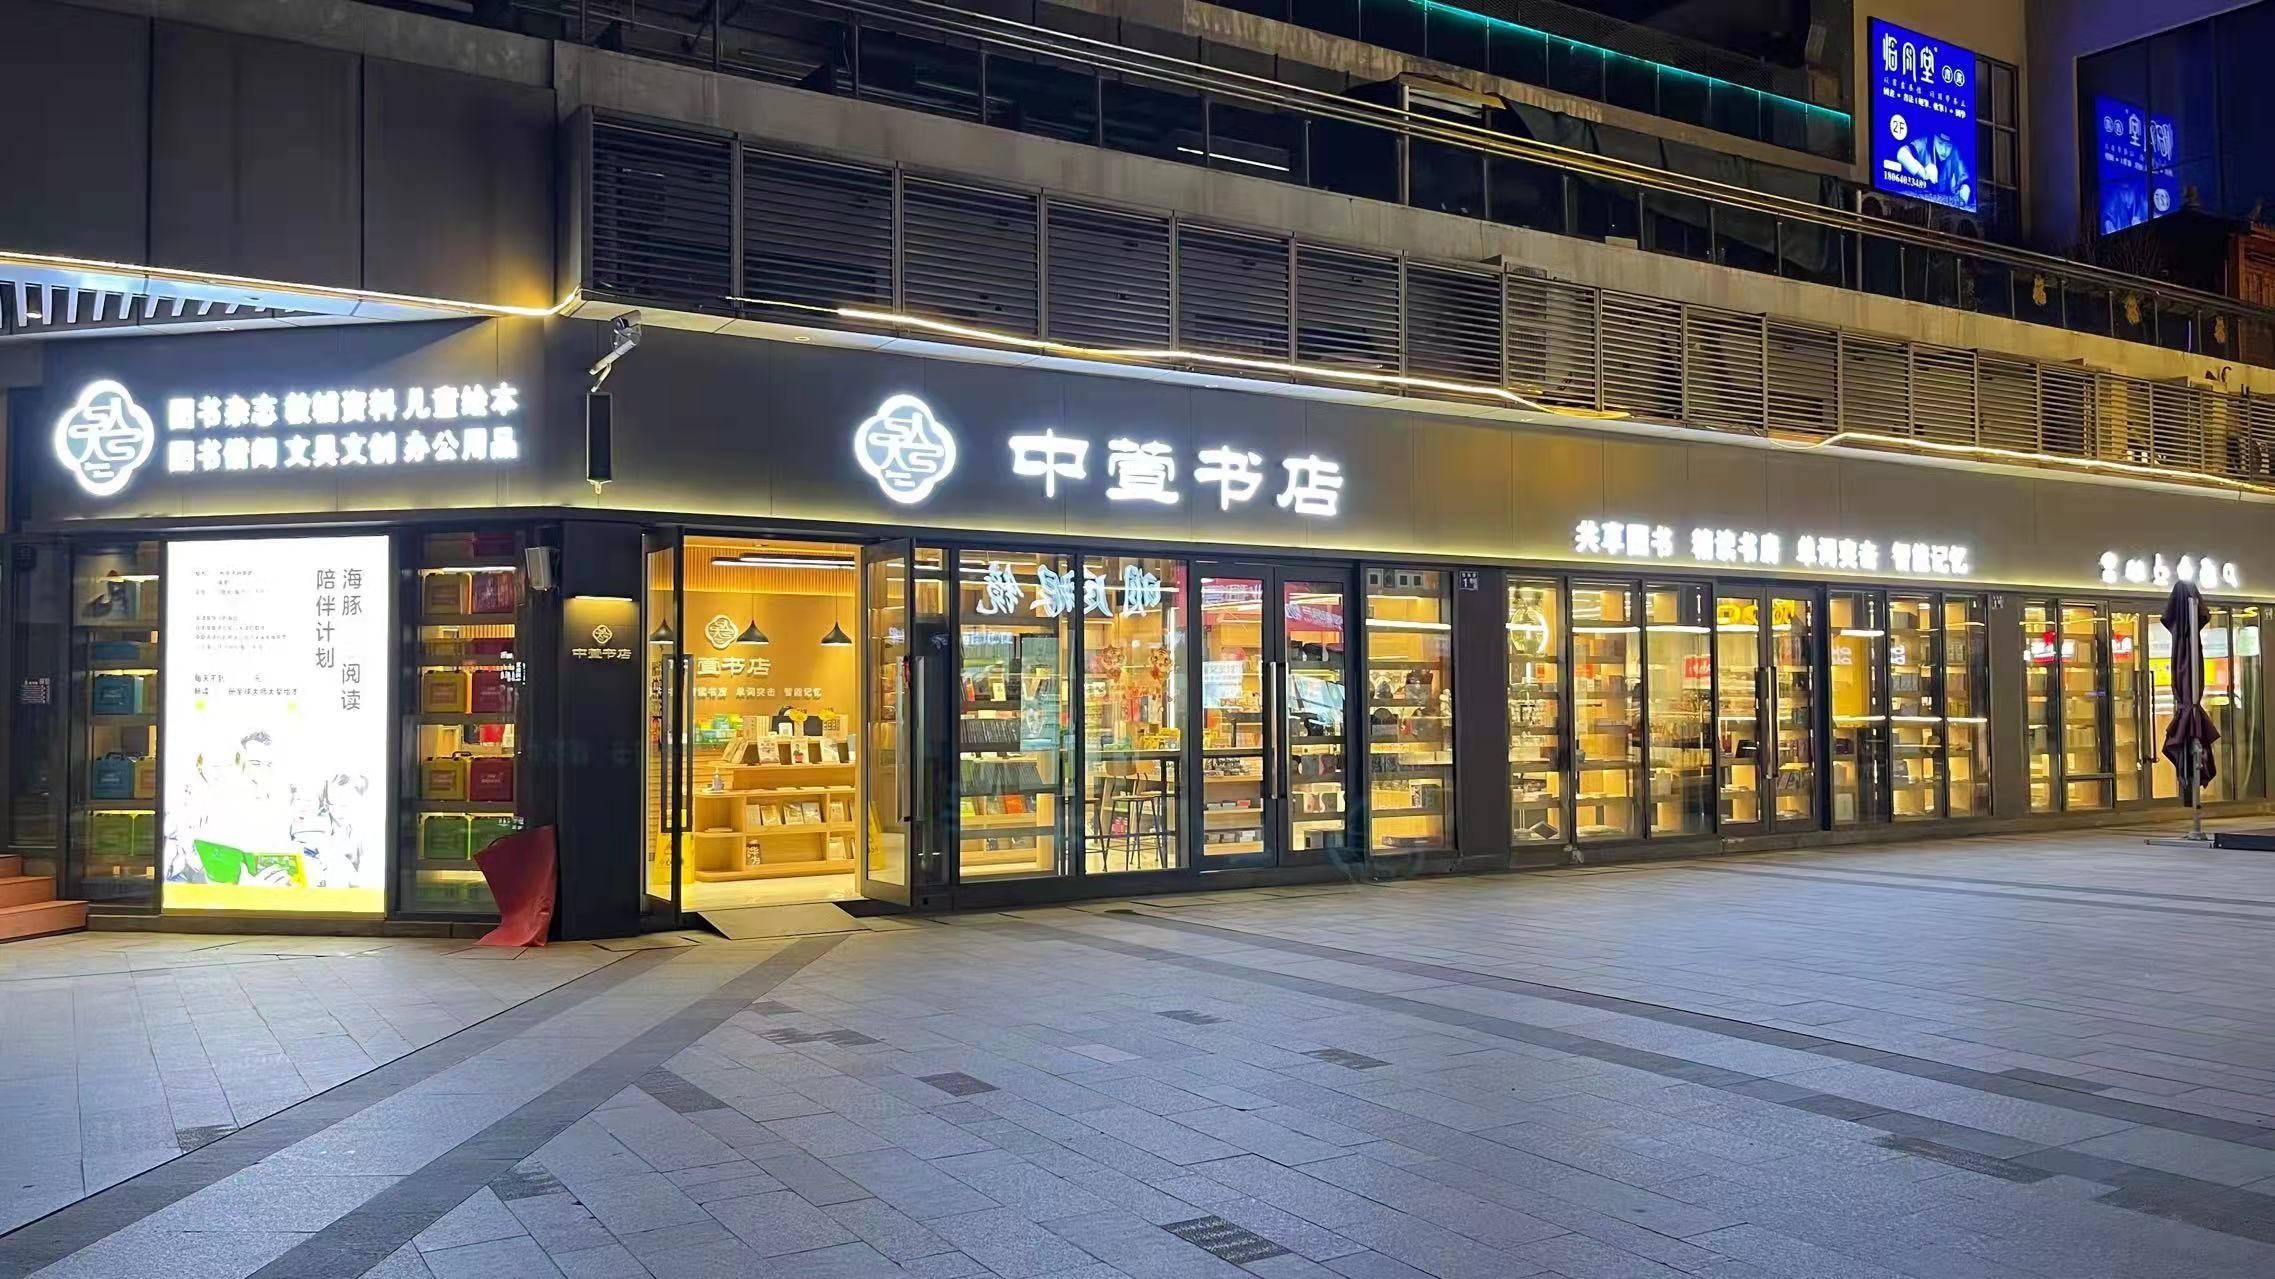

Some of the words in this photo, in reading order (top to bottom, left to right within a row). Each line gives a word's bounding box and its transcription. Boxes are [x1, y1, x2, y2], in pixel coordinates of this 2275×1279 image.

[1893, 121, 1905, 135] 2F
[1008, 429, 1343, 517] 中萱书店
[342, 568, 362, 616] 海豚
[315, 568, 336, 668] 陪伴计划
[341, 662, 361, 711] 阅读
